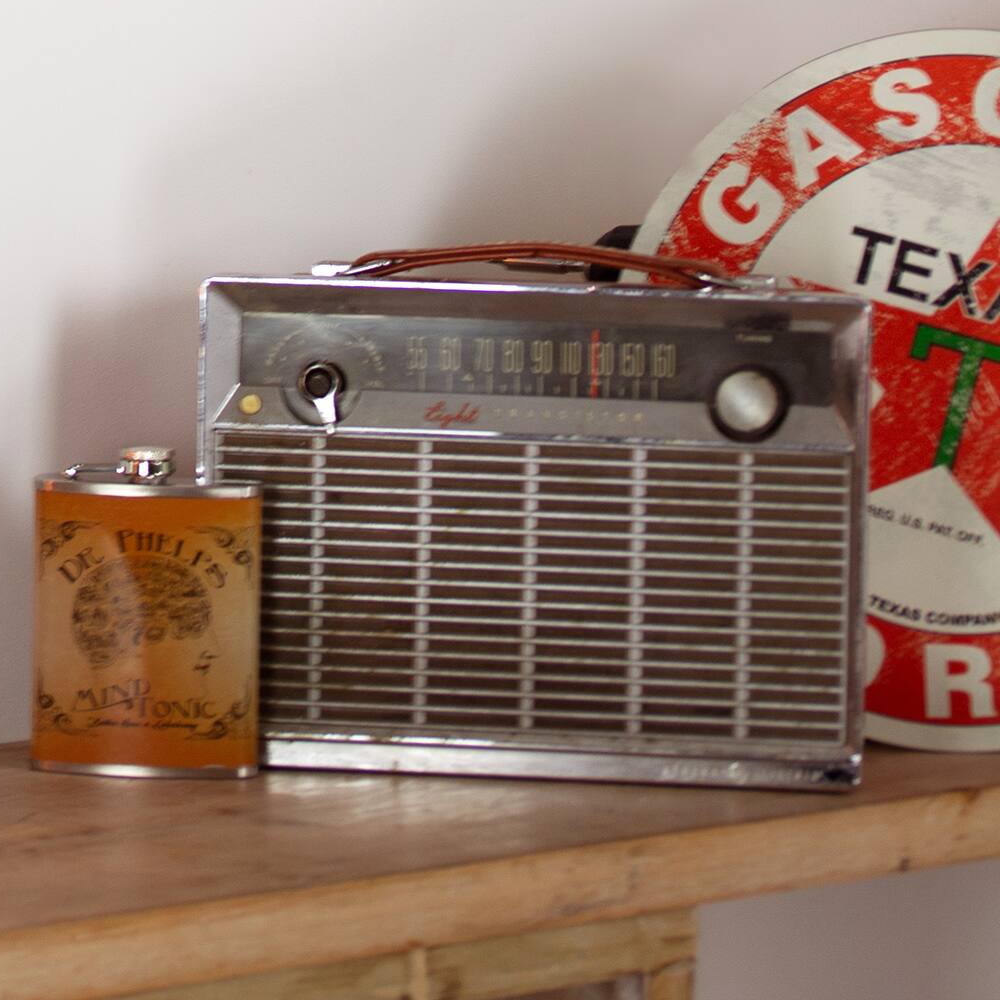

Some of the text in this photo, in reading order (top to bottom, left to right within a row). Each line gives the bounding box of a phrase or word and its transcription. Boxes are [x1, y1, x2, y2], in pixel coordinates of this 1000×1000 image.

[531, 339, 553, 374] 90
[869, 593, 922, 621] TEXAS
[131, 698, 217, 719] TONIC
